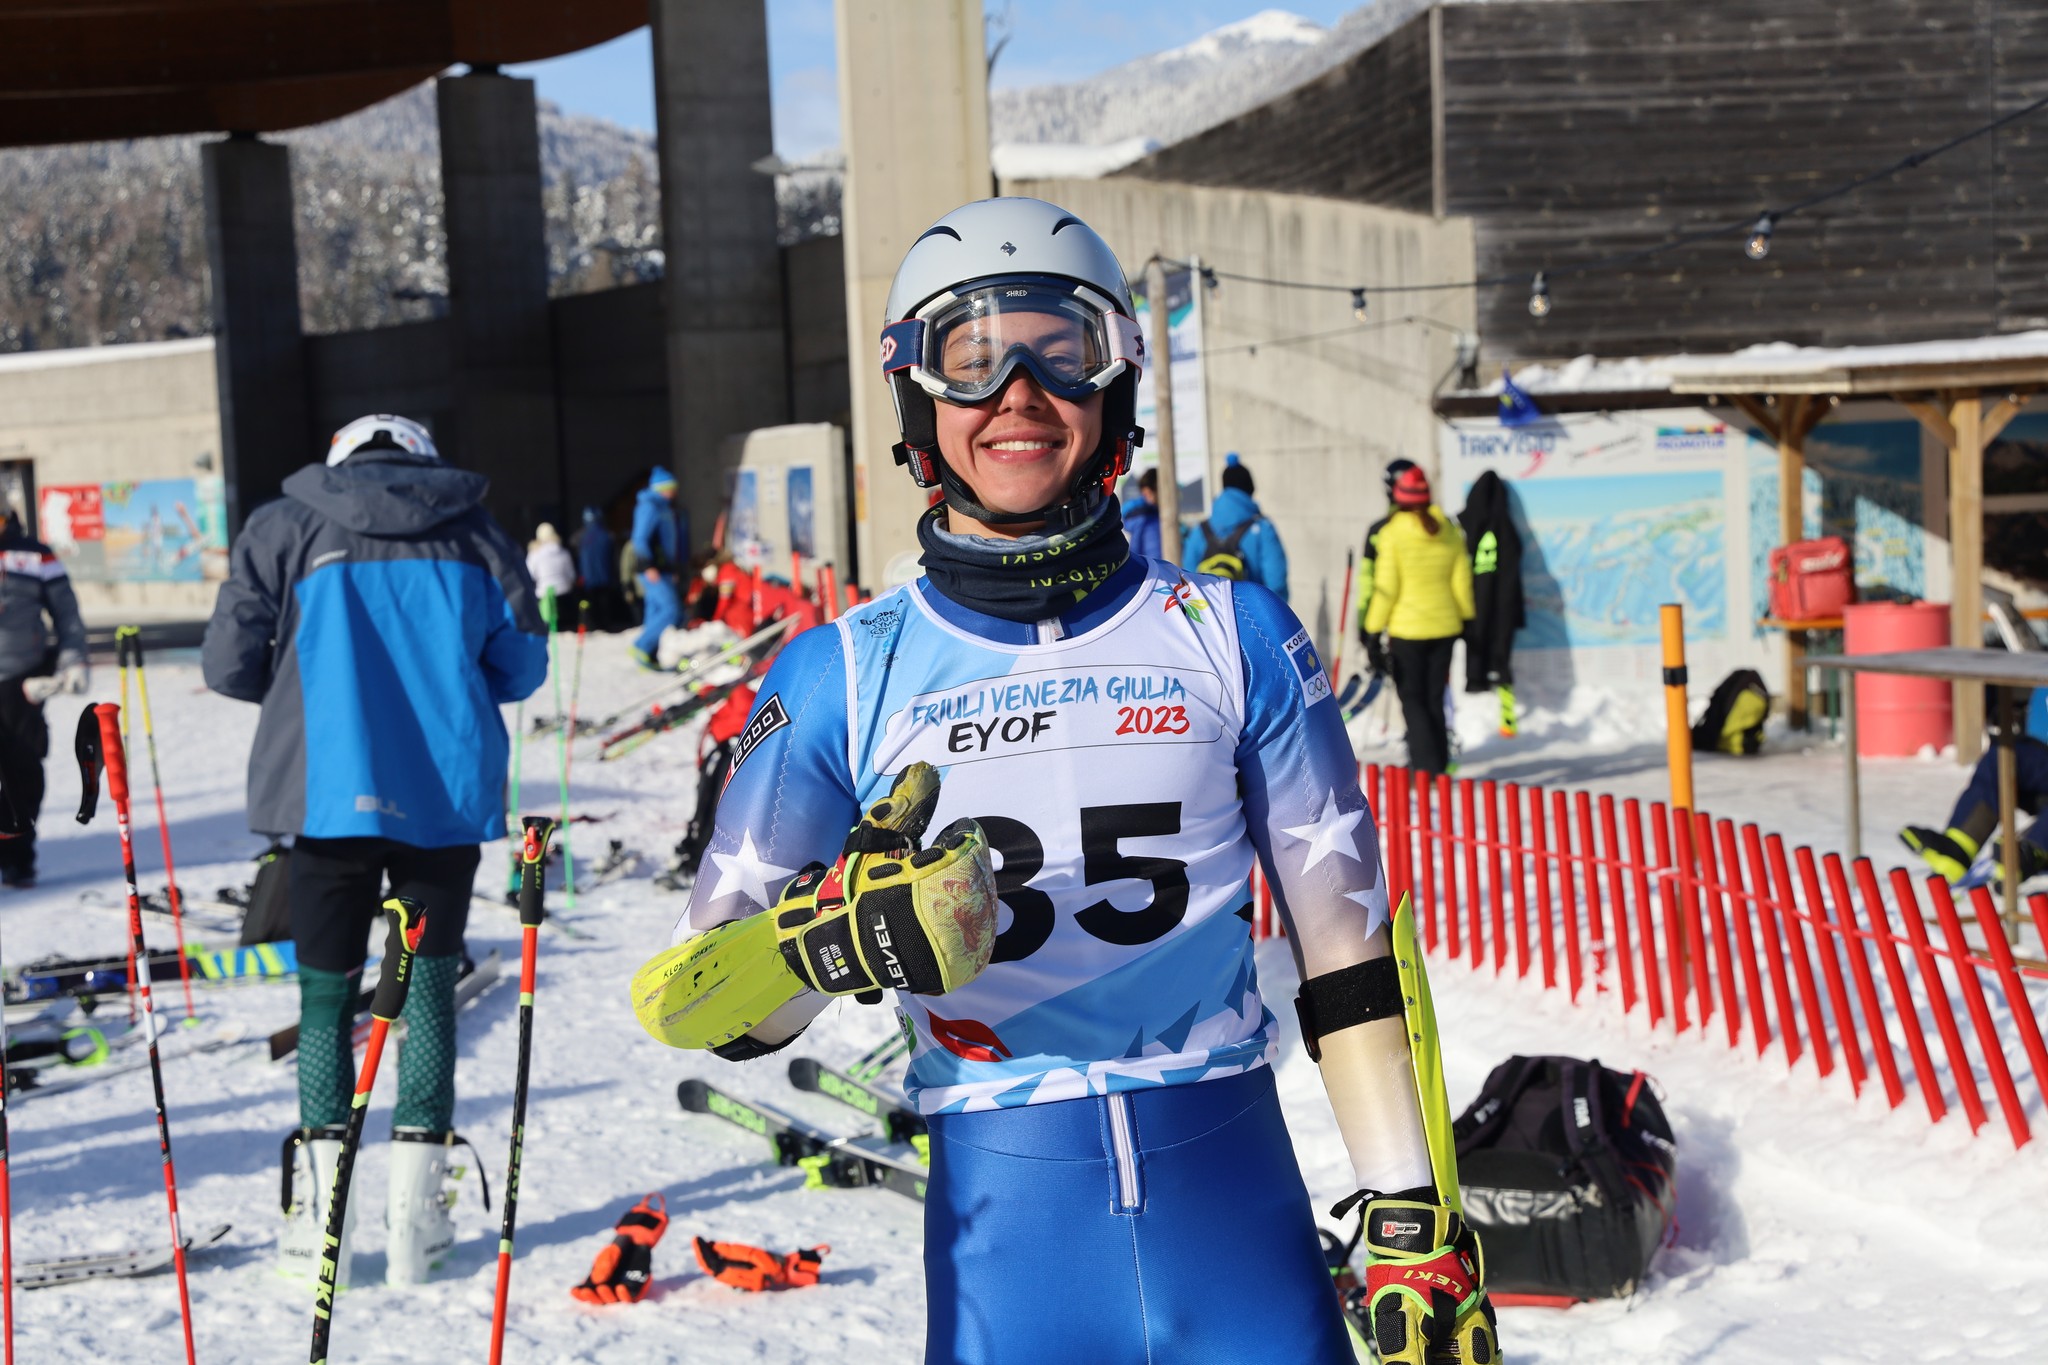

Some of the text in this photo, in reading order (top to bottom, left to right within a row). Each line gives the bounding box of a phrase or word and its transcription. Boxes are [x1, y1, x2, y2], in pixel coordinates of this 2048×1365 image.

[1006, 289, 1028, 298] SHRED
[911, 675, 1187, 730] FRIULI VENEZIA GIULIA
[947, 704, 1191, 753] EYOF 2023
[819, 946, 836, 973] WORLD
[829, 943, 842, 959] CUP
[874, 914, 909, 989] LEVEL
[396, 952, 409, 983] LEKI
[314, 1231, 340, 1321] LEKI
[1403, 1269, 1463, 1294] LEKI
